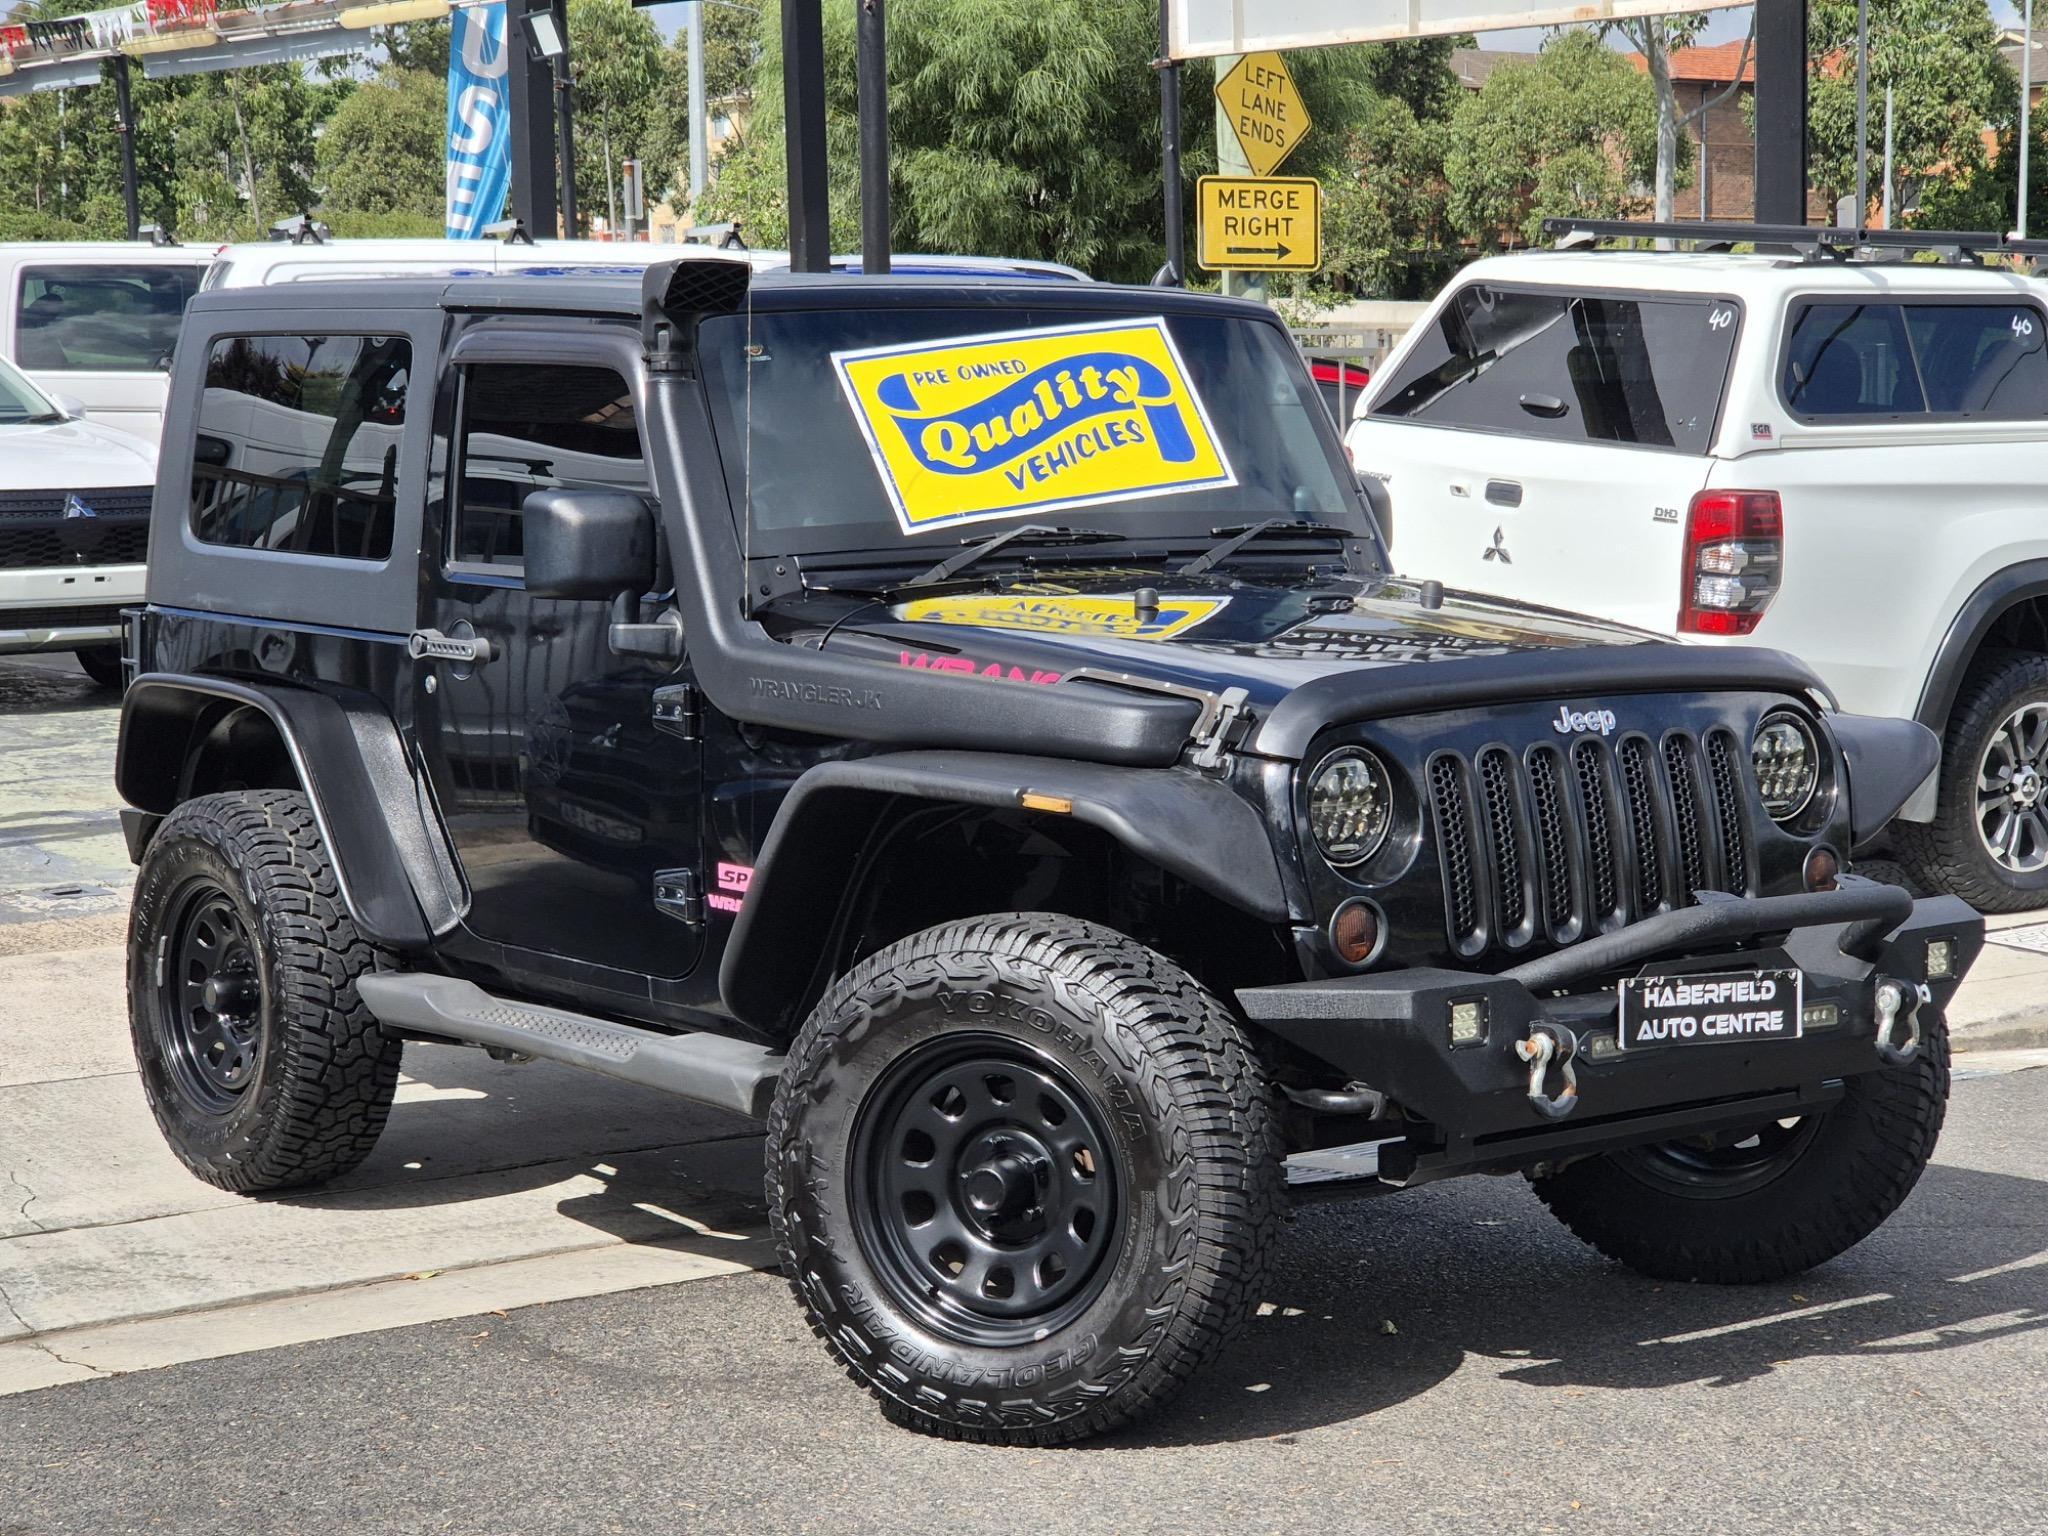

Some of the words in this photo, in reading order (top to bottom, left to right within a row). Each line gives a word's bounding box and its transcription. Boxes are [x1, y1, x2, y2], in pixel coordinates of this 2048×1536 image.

[1245, 62, 1286, 94] LEFT
[1241, 88, 1287, 123] LANE
[1239, 115, 1286, 149] ENDS
[1218, 188, 1300, 211] MERGE
[1224, 215, 1294, 237] RIGHT
[1708, 308, 1733, 331] 40
[911, 368, 951, 388] PRE
[957, 358, 1028, 382] OWNED
[920, 363, 1142, 470] Quality
[1751, 424, 1772, 435] EGR
[1004, 418, 1146, 492] VEHICLES
[749, 676, 852, 706] WRANGLER
[856, 689, 883, 711] JK
[1552, 705, 1617, 736] Jeep
[1643, 980, 1777, 1009] HABERFIELD
[1636, 1015, 1698, 1041] AUTO
[1701, 1010, 1785, 1037] CENTRE
[936, 989, 1148, 1142] YOKOHAMA
[840, 1280, 1099, 1391] GEOLANDAR
